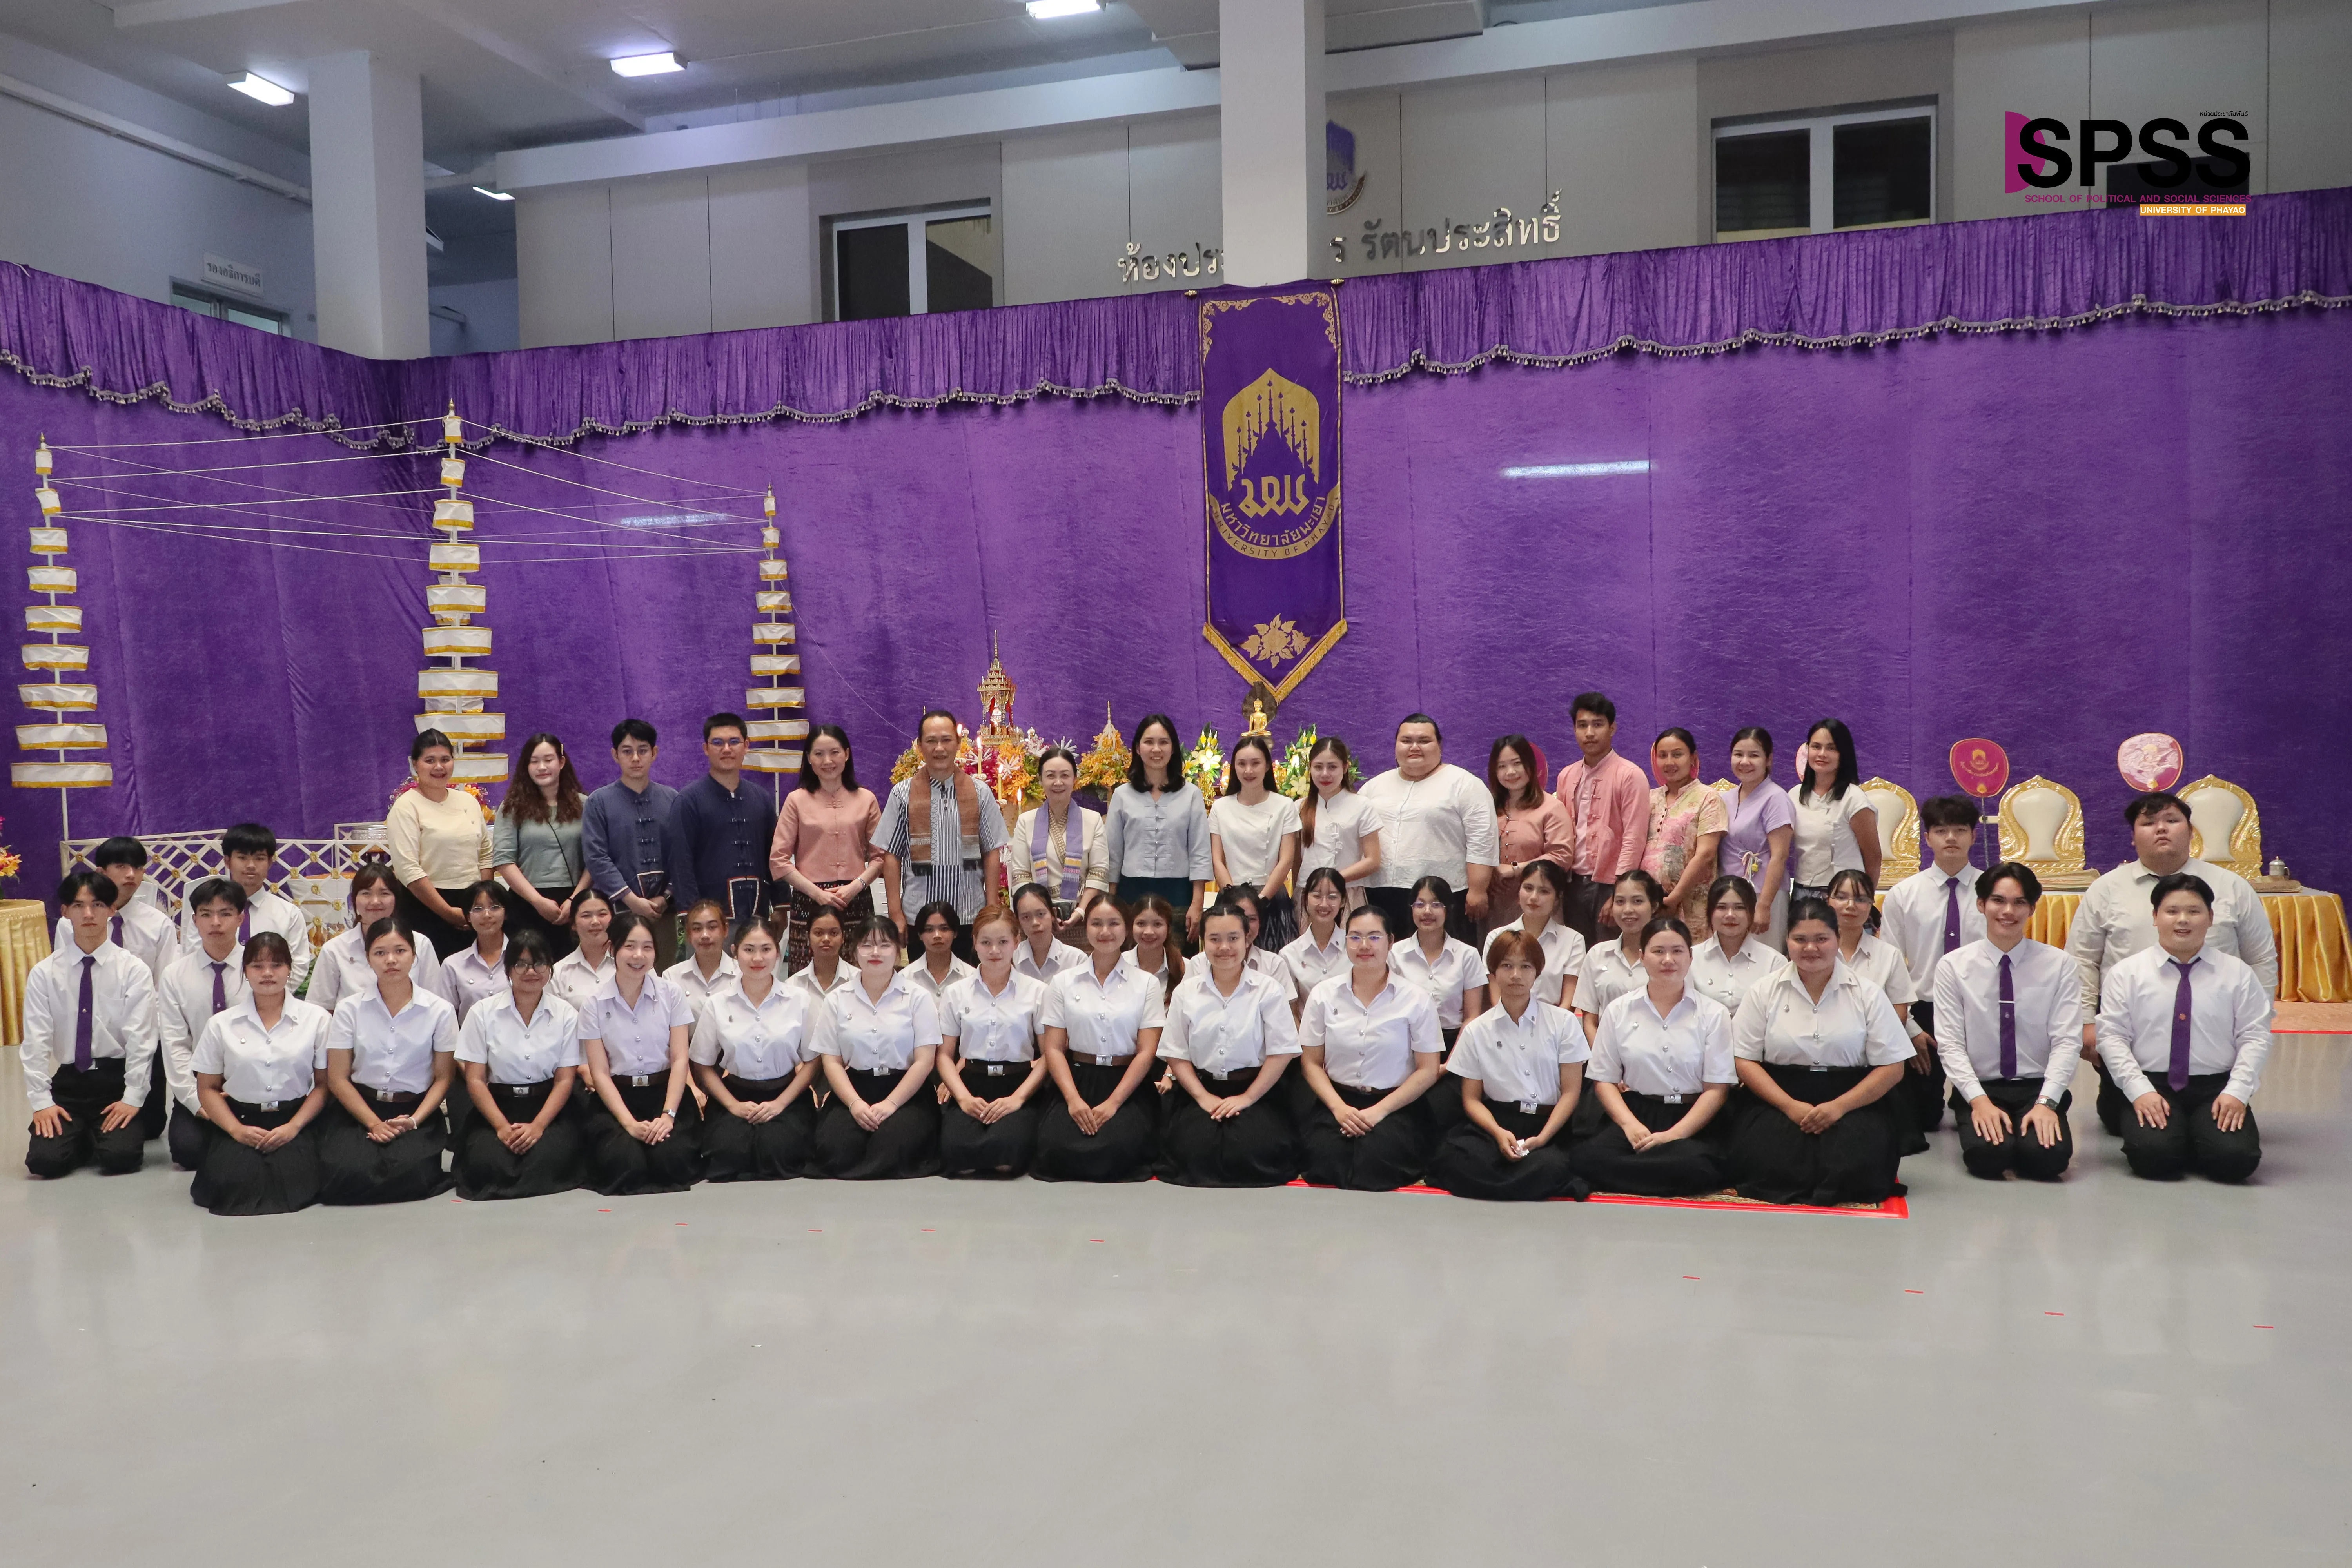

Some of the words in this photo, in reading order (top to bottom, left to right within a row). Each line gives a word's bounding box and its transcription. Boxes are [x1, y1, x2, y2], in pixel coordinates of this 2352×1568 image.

[1118, 242, 1223, 282] ห้องปร
[1361, 188, 1562, 260] รัตนประสิทธิ์
[1214, 511, 1278, 557] UNIVERSITY
[1285, 546, 1302, 556] OF
[1304, 505, 1335, 548] PHAYAO
[1221, 497, 1325, 546] มหาวิทยาลัยพะเยา
